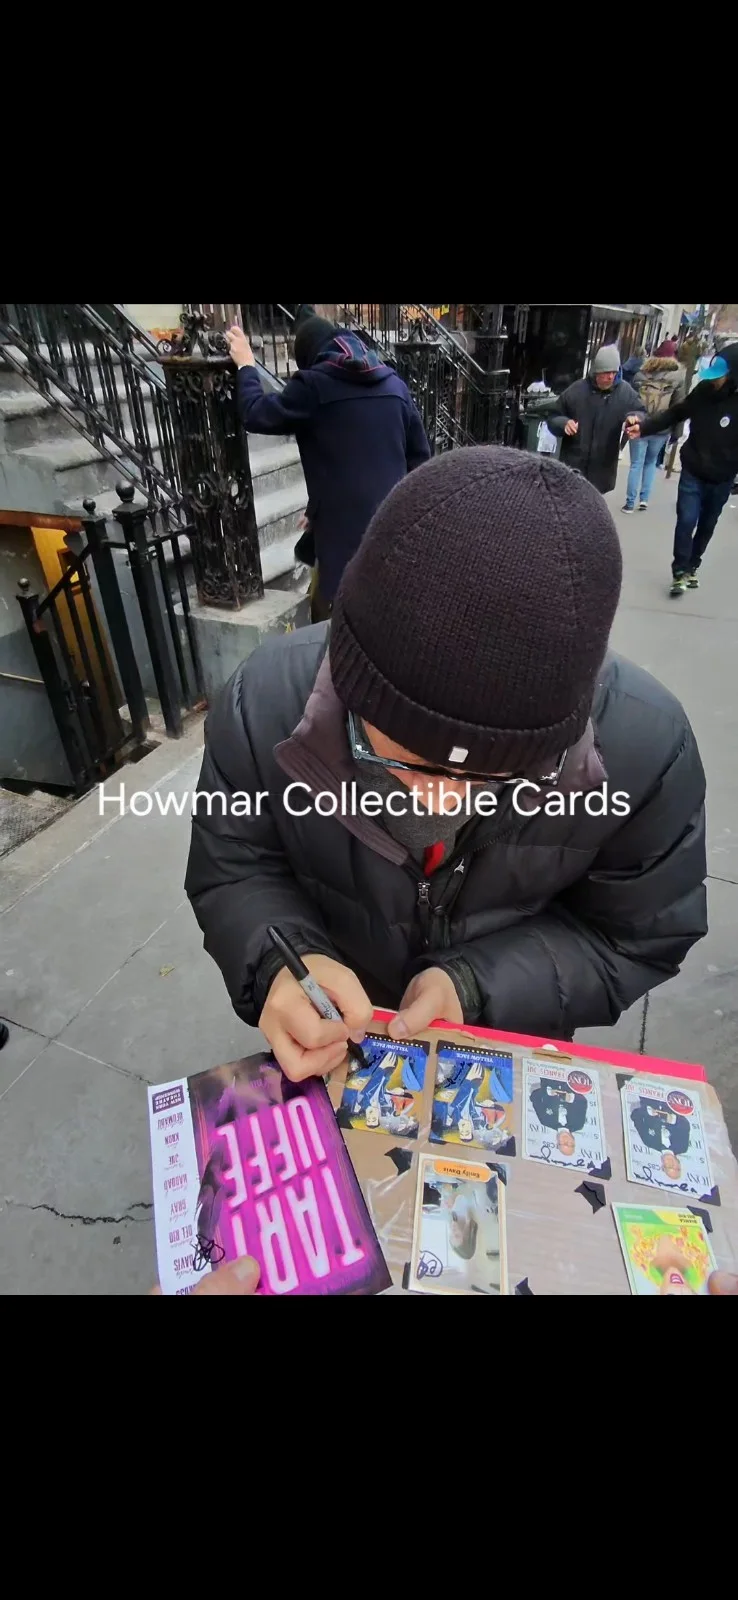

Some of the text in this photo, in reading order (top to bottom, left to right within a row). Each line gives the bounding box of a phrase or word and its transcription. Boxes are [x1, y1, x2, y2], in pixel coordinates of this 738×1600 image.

[386, 1043, 409, 1053] YELLOW
[456, 1052, 494, 1064] YELLOW FACE
[155, 1093, 181, 1106] THEATRE
[155, 1097, 182, 1110] NEW YORK
[164, 1132, 180, 1145] KRON
[217, 1096, 326, 1208] UFFE
[443, 1166, 461, 1175] Davis
[647, 1162, 661, 1171] CBS
[462, 1169, 480, 1179] Emily
[173, 1254, 194, 1272] DAVIS
